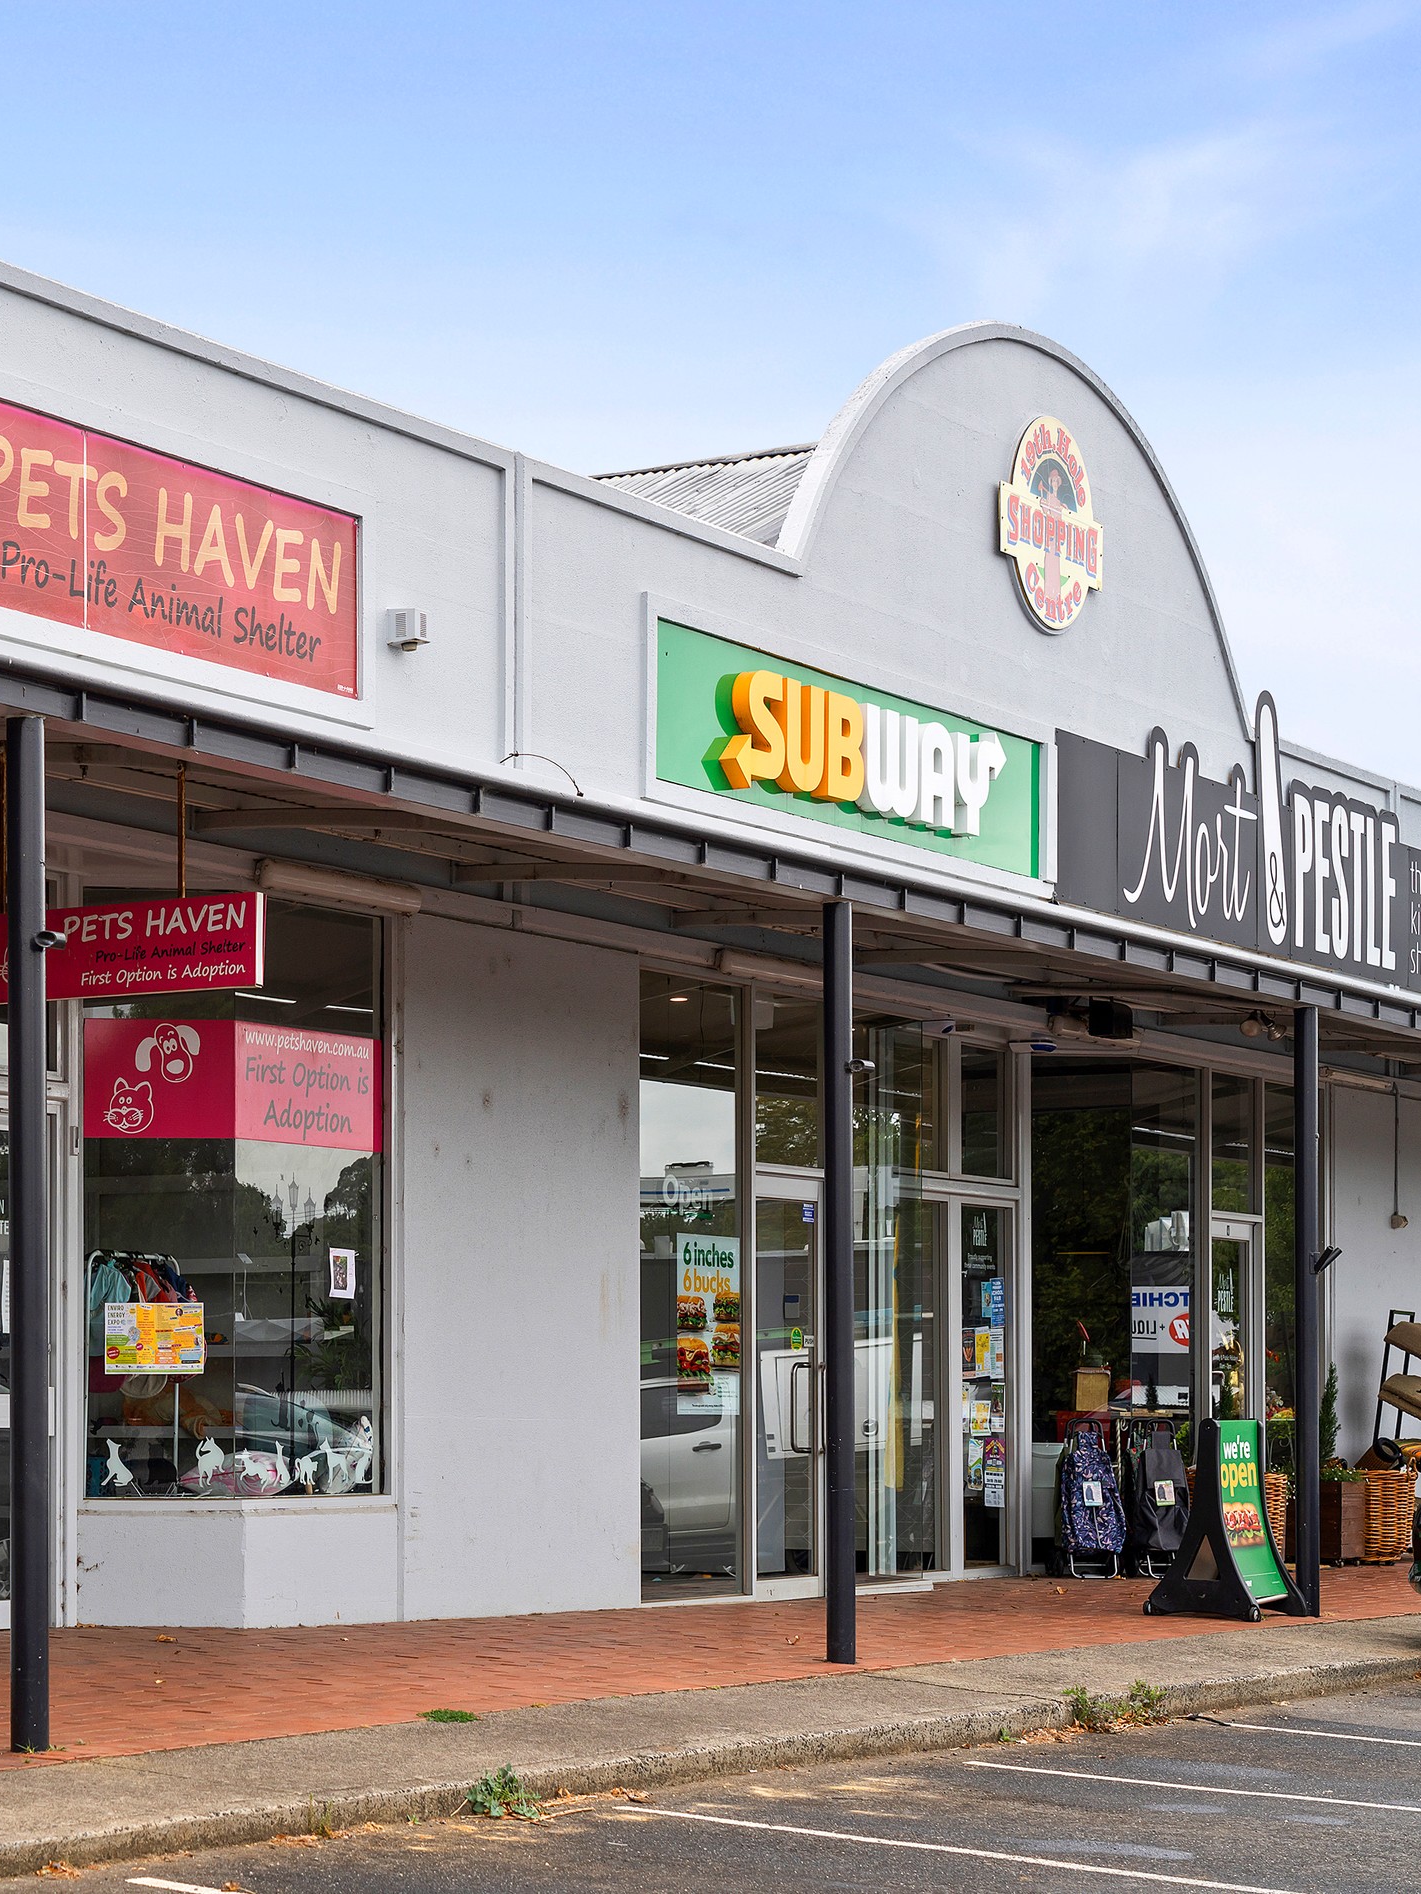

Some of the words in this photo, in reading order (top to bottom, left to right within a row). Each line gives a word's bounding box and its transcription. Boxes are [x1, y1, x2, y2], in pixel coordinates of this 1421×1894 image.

[1056, 428, 1086, 508] Hole
[155, 487, 342, 615] HAVEN
[1007, 494, 1099, 579] SHOPPING
[1, 540, 118, 608] Pro-Life
[128, 578, 224, 638] Animal
[233, 605, 322, 662] Shelter
[1025, 562, 1082, 624] Centre
[717, 669, 1008, 838] SUBWAY
[1123, 741, 1258, 929] Mort
[1293, 793, 1396, 971] PESTLE
[63, 911, 133, 943] PETS
[145, 900, 247, 937] HAVEN
[81, 971, 112, 987] First
[116, 966, 162, 988] Option
[167, 964, 177, 980] is
[181, 959, 246, 982] Adoption
[95, 945, 147, 964] Pro-Life
[151, 942, 197, 959] Animal
[200, 939, 246, 956] Shelter
[245, 1031, 369, 1060] www.petshaven.com.au
[245, 1054, 286, 1085] First
[292, 1062, 351, 1098] Option
[357, 1066, 369, 1095] is
[263, 1098, 353, 1142] Adoption
[662, 1173, 714, 1217] Open
[683, 1241, 692, 1266] 6
[693, 1242, 735, 1269] inches
[683, 1268, 692, 1293] 6
[693, 1268, 731, 1294] bucks
[1223, 1434, 1251, 1460] we're
[1220, 1461, 1258, 1497] open
